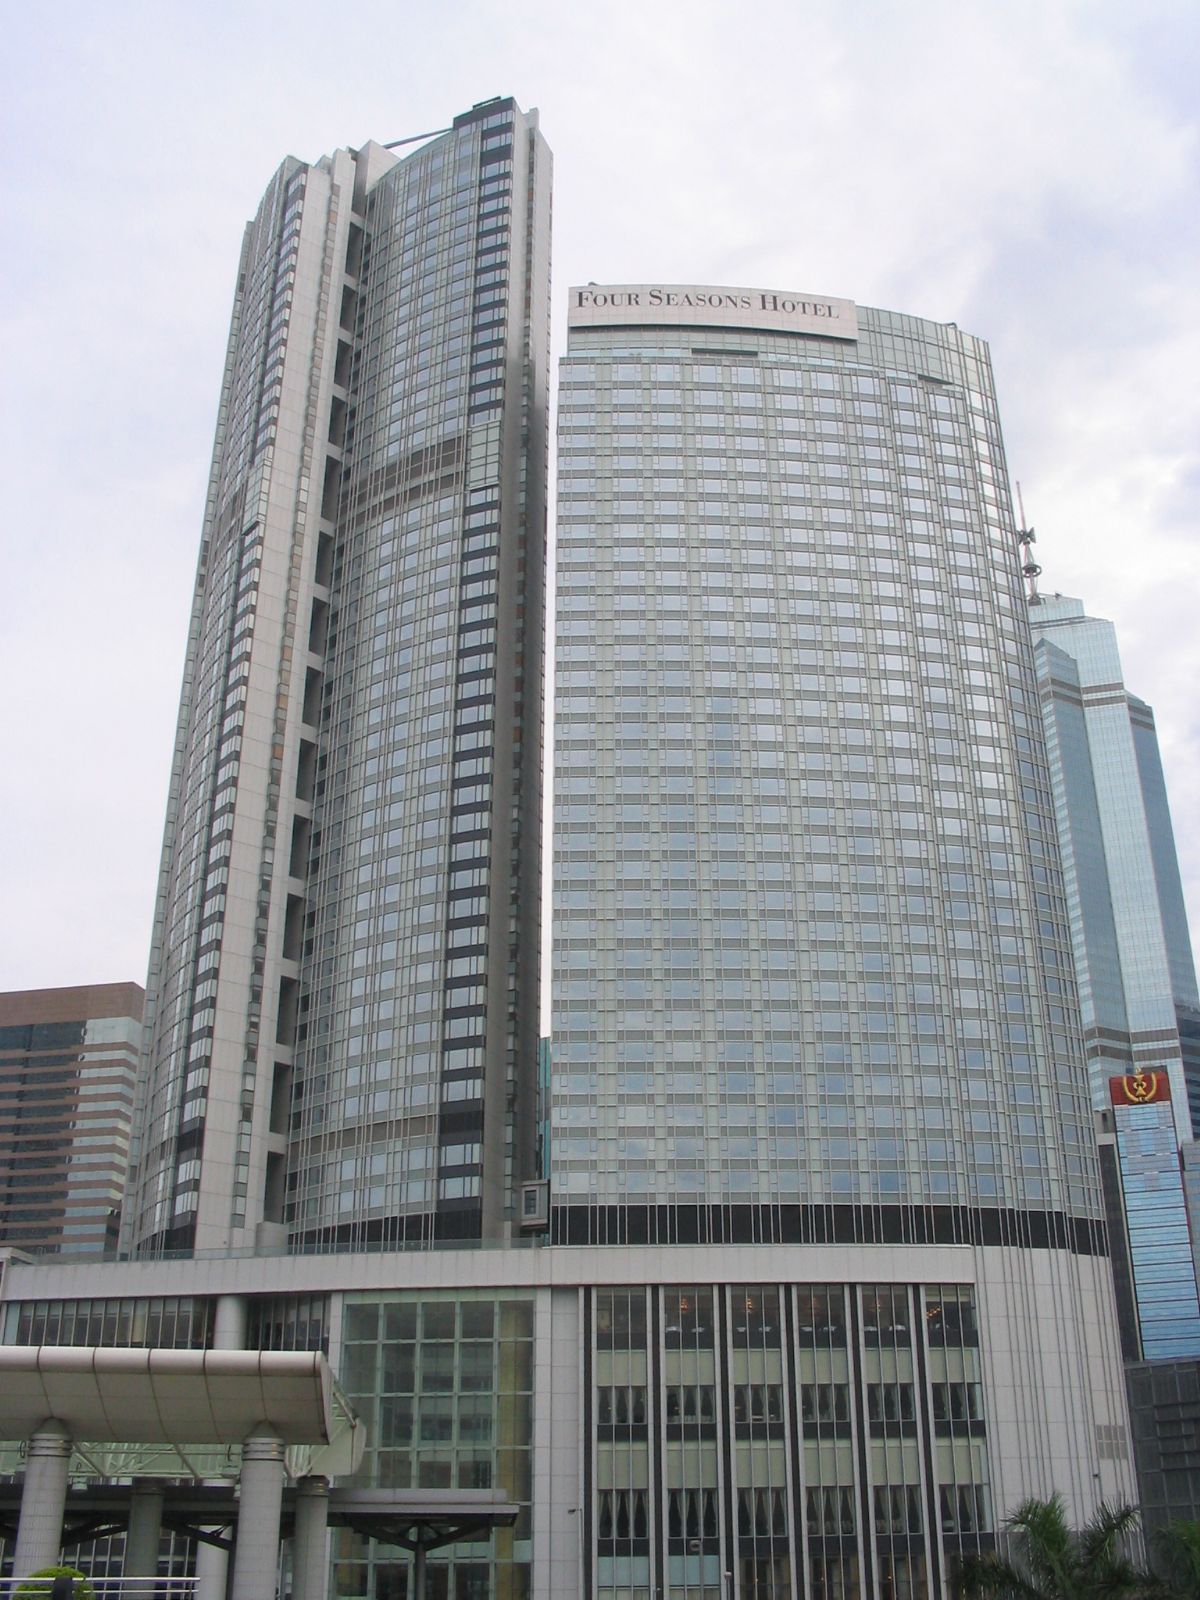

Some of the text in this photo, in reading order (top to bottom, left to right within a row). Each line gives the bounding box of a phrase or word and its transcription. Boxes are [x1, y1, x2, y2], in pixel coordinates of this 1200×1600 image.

[576, 288, 840, 319] FOUR SEASONS HOTEL
